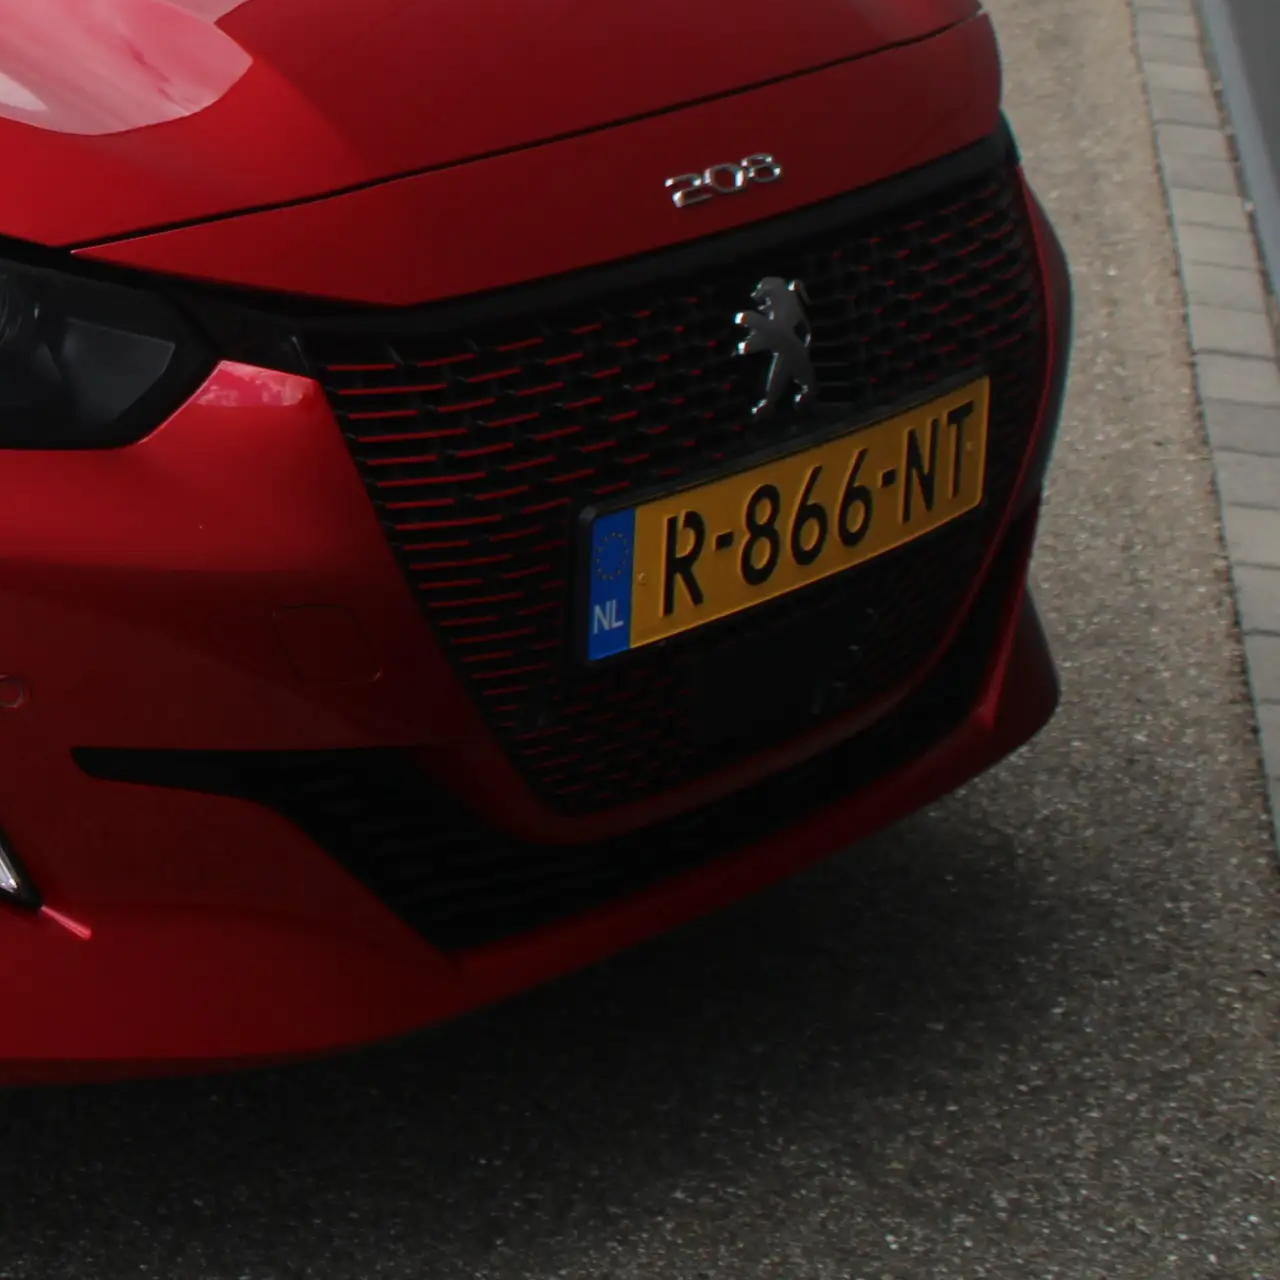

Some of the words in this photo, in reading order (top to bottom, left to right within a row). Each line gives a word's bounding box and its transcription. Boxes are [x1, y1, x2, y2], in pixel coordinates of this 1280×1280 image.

[664, 153, 781, 207] 208
[661, 405, 973, 616] R-866-NT
[592, 600, 624, 635] NL
